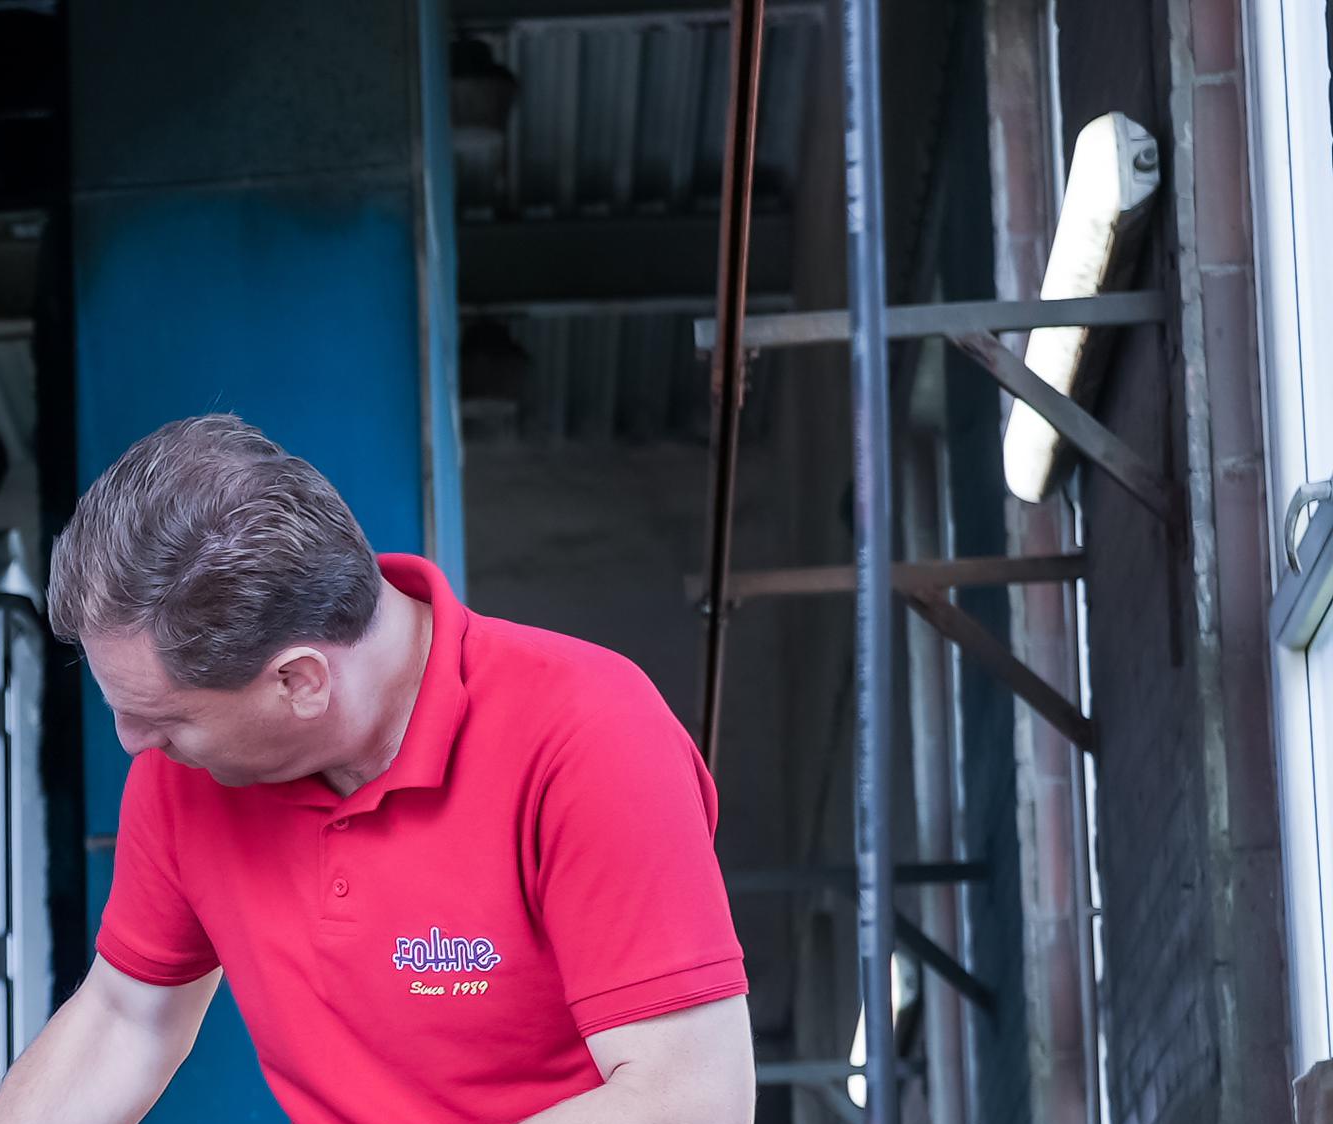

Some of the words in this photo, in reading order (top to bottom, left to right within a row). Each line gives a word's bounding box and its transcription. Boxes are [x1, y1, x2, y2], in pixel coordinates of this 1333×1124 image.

[392, 926, 501, 972] roline
[409, 980, 445, 996] Since
[452, 980, 488, 996] 1989
